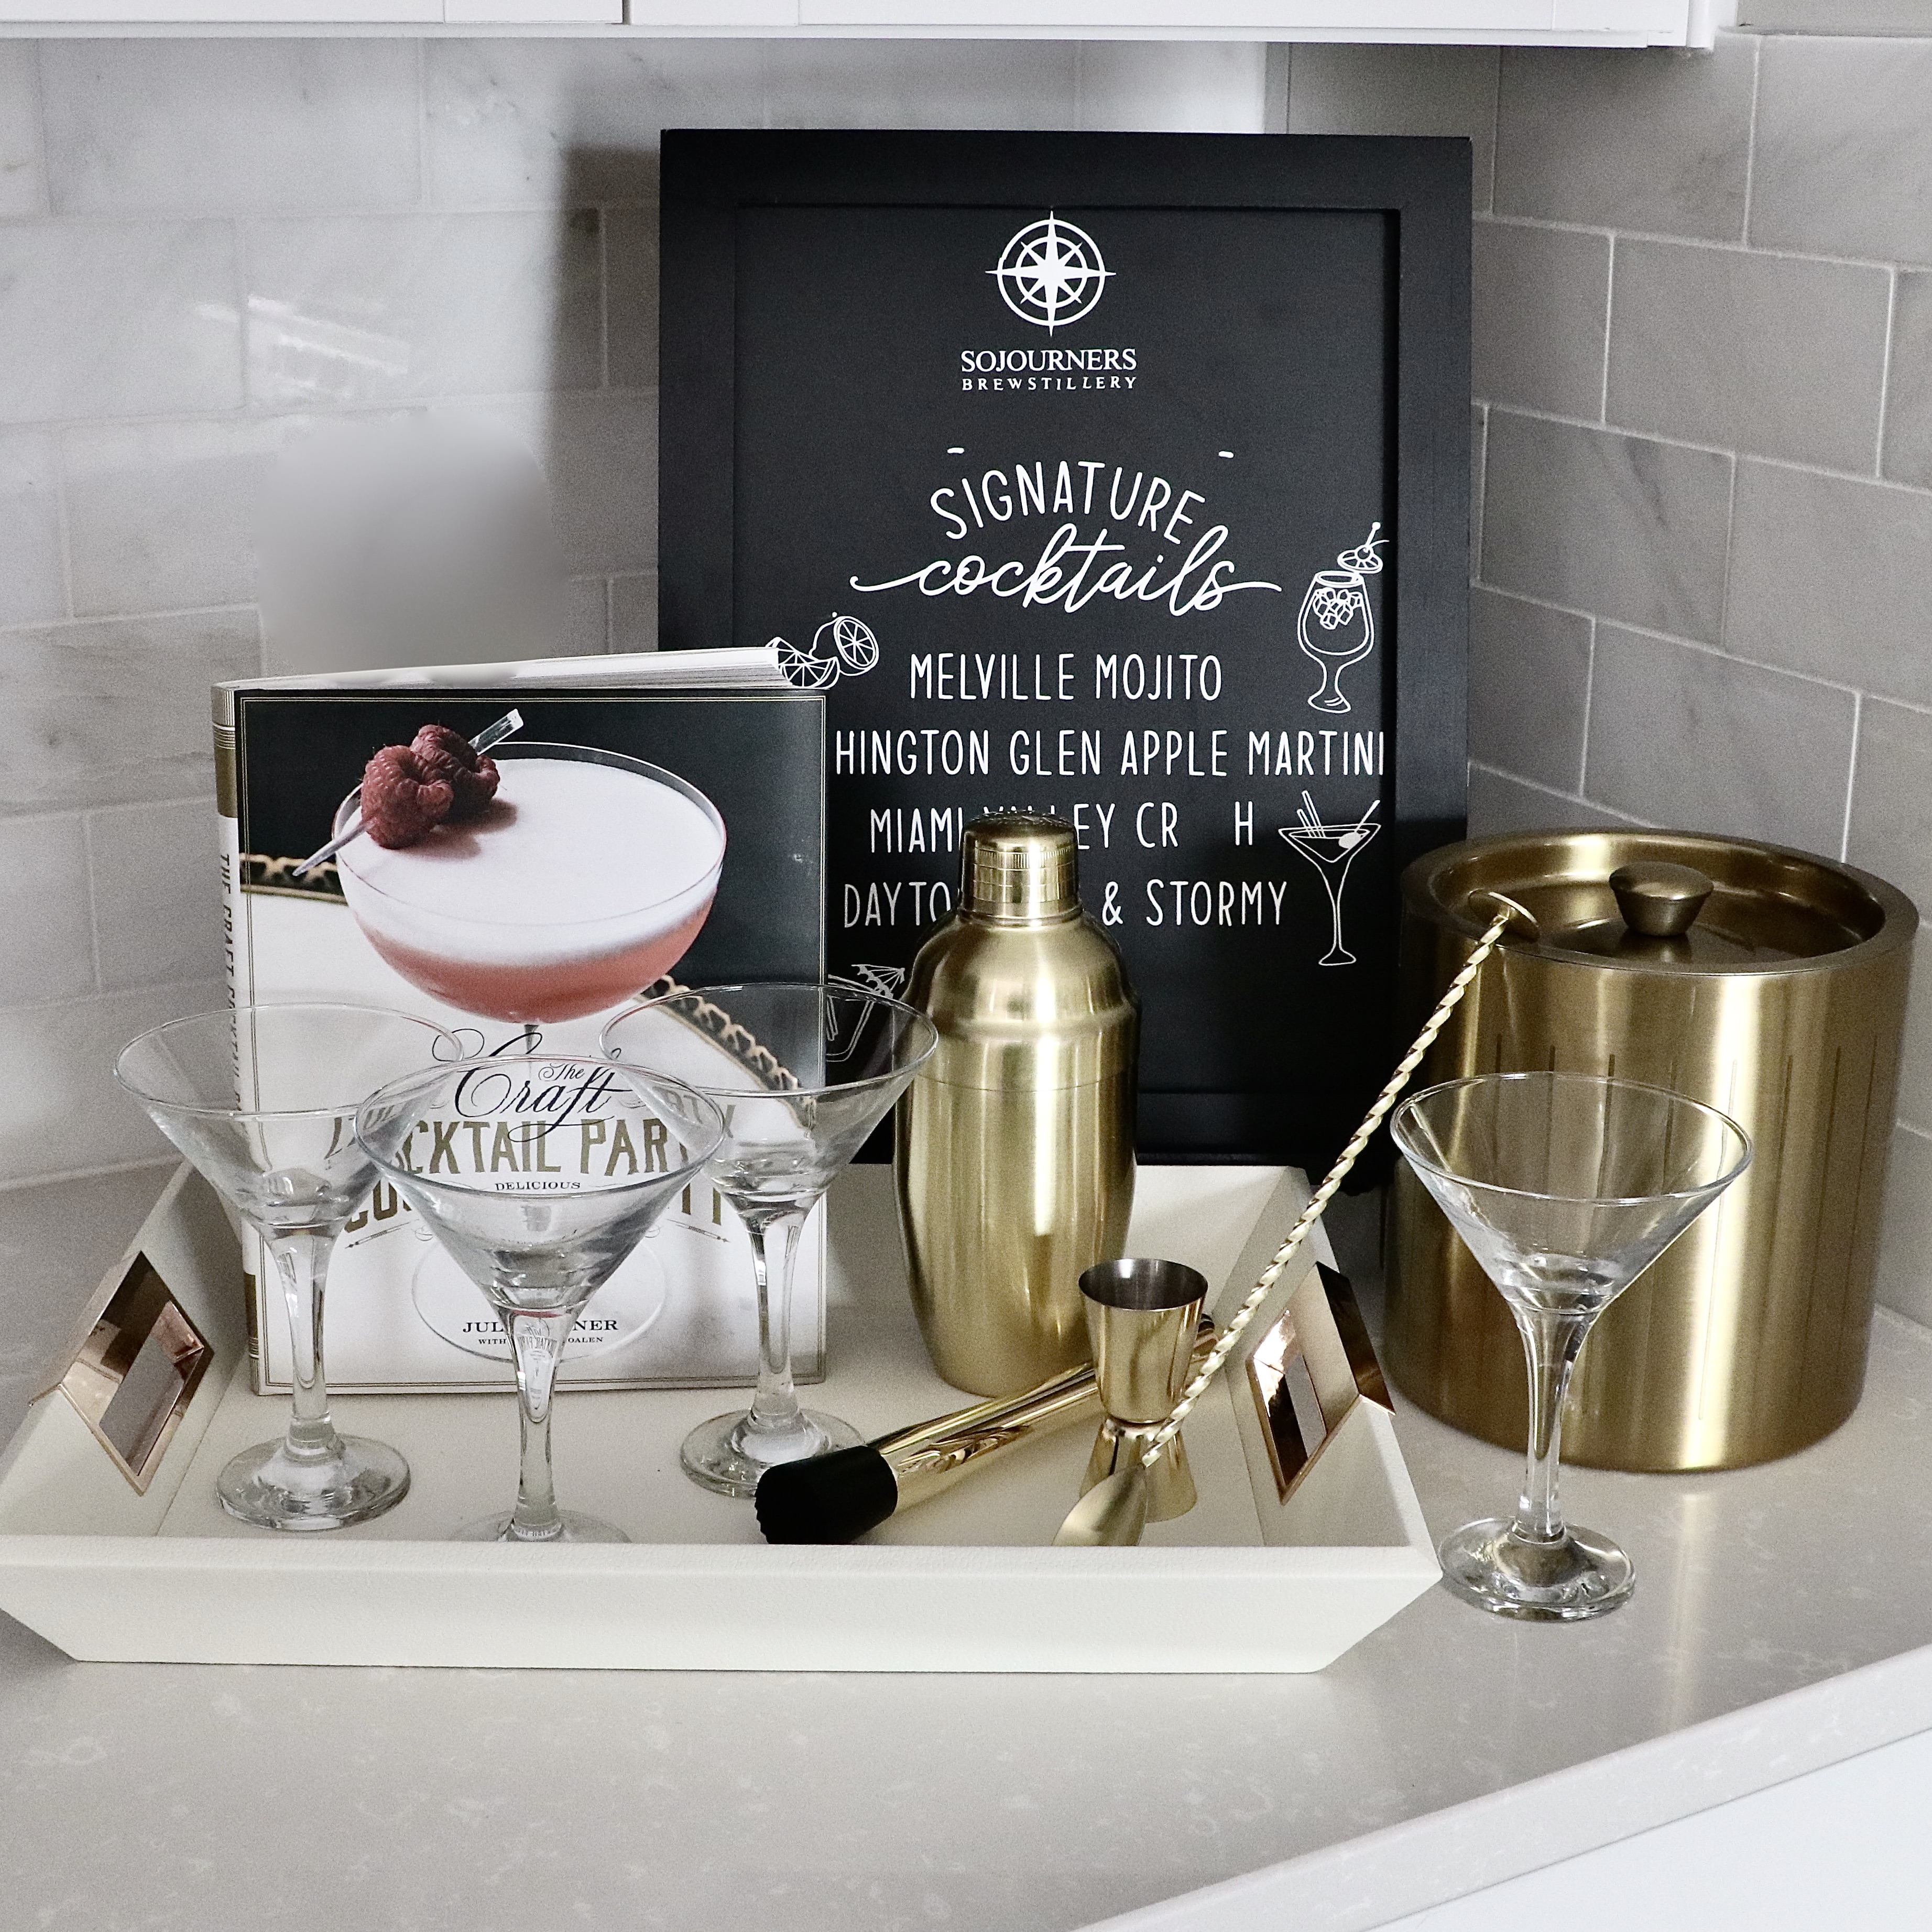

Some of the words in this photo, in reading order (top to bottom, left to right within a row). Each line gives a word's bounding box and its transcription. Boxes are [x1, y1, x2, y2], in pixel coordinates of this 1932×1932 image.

[961, 348, 1137, 373] SOJOURNERS
[962, 376, 1137, 391] BREWSTILLERY
[930, 461, 1206, 544] SIGNATURE
[849, 523, 1282, 617] cocktails
[911, 653, 1074, 700] MELVILLE
[1096, 653, 1222, 701] MOJITO
[836, 729, 989, 775] HINGTON
[1010, 729, 1101, 776] GLEN
[1120, 730, 1228, 777] APPLE
[1249, 730, 1384, 776] MARTINI
[870, 807, 963, 853] MIAMI
[844, 881, 952, 928] DAYTO
[1102, 881, 1123, 926] &
[1146, 879, 1287, 926] STORMY
[433, 1028, 633, 1142] Craft
[538, 1063, 585, 1082] The
[495, 1181, 581, 1191] DELICIOUS
[462, 1322, 504, 1333] JUL
[573, 1319, 619, 1331] NER
